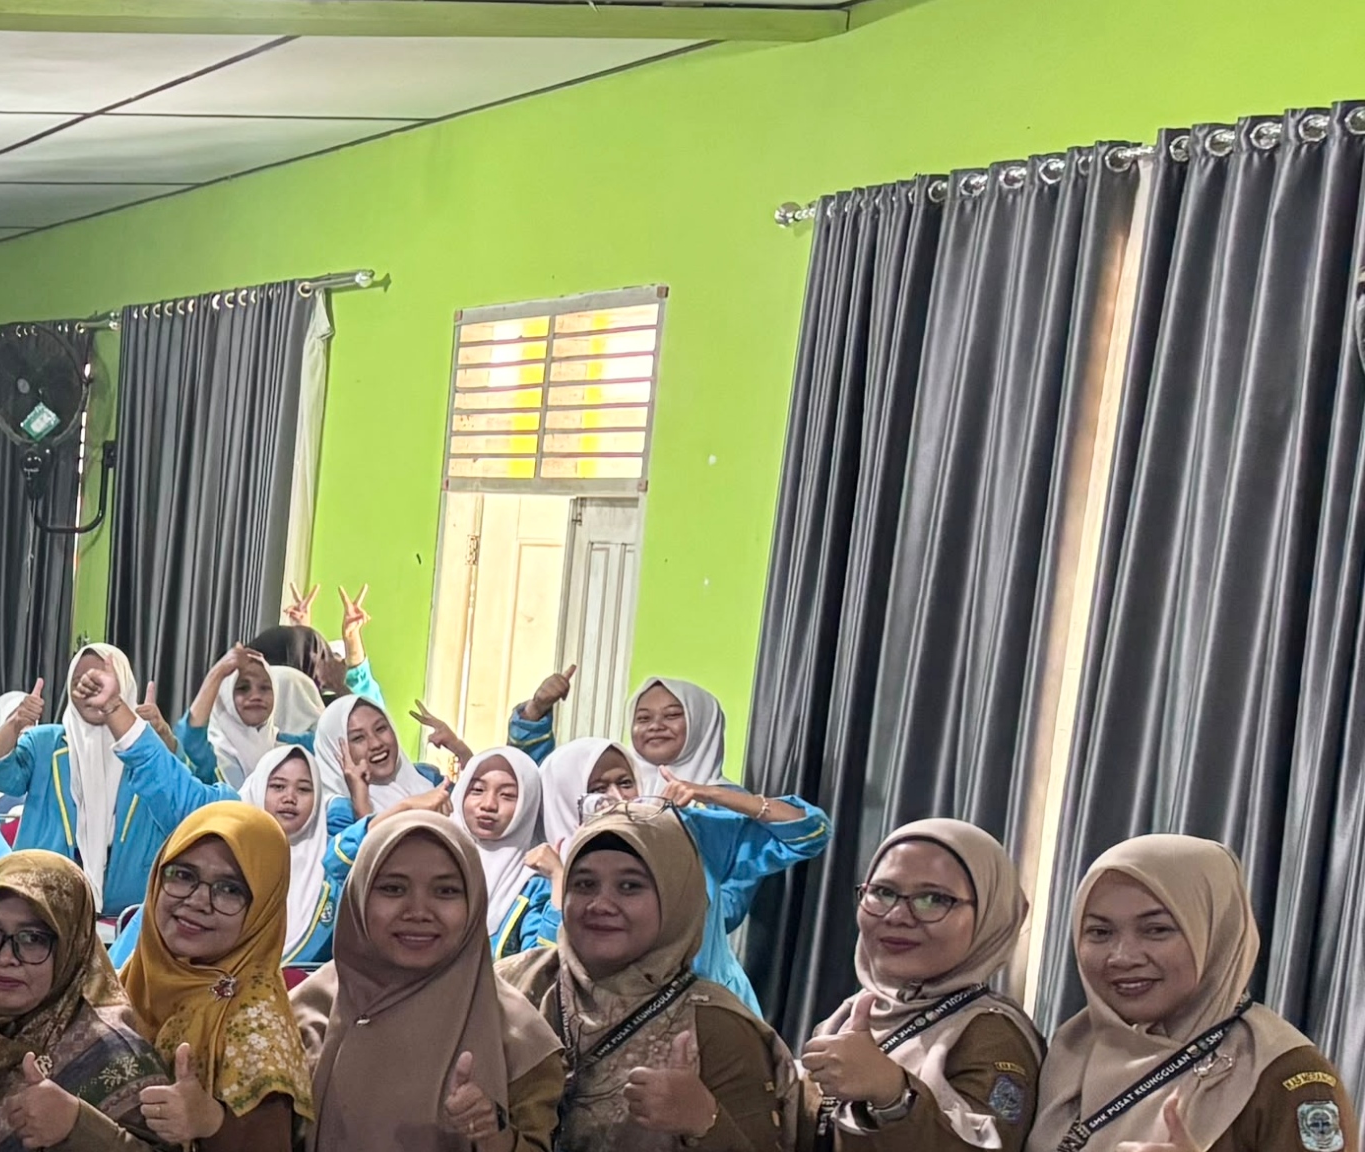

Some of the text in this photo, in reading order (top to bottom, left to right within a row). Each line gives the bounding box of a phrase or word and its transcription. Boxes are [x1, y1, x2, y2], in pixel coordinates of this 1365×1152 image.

[899, 1025, 917, 1039] SMK
[1089, 1114, 1107, 1129] SMK
[1107, 1093, 1135, 1117] PUSAT
[1135, 1053, 1191, 1096] KEUNGGULAN
